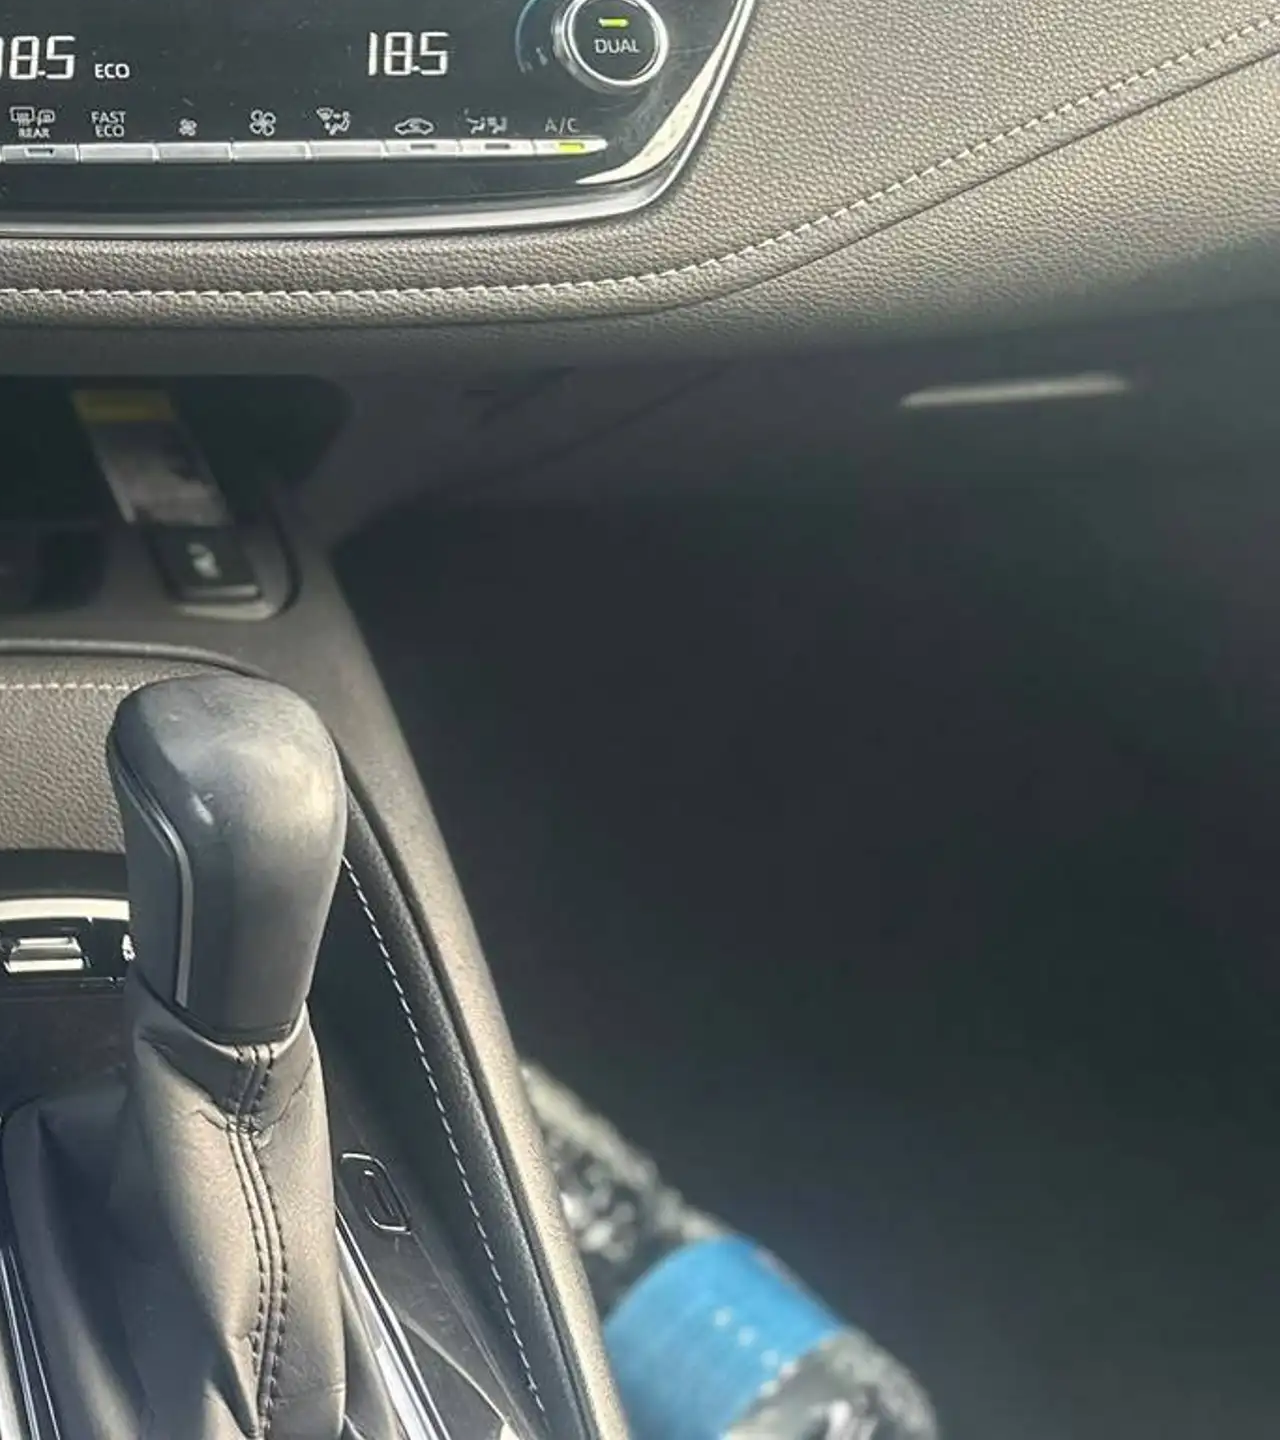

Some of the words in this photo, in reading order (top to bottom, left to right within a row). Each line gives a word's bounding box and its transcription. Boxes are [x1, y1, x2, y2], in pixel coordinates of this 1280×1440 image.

[368, 30, 450, 77] 18.5
[593, 38, 641, 55] DUAL
[93, 62, 130, 80] ECO
[91, 111, 127, 125] FAST
[544, 117, 581, 135] A/C
[17, 127, 51, 140] REAR
[94, 124, 126, 139] ECO
